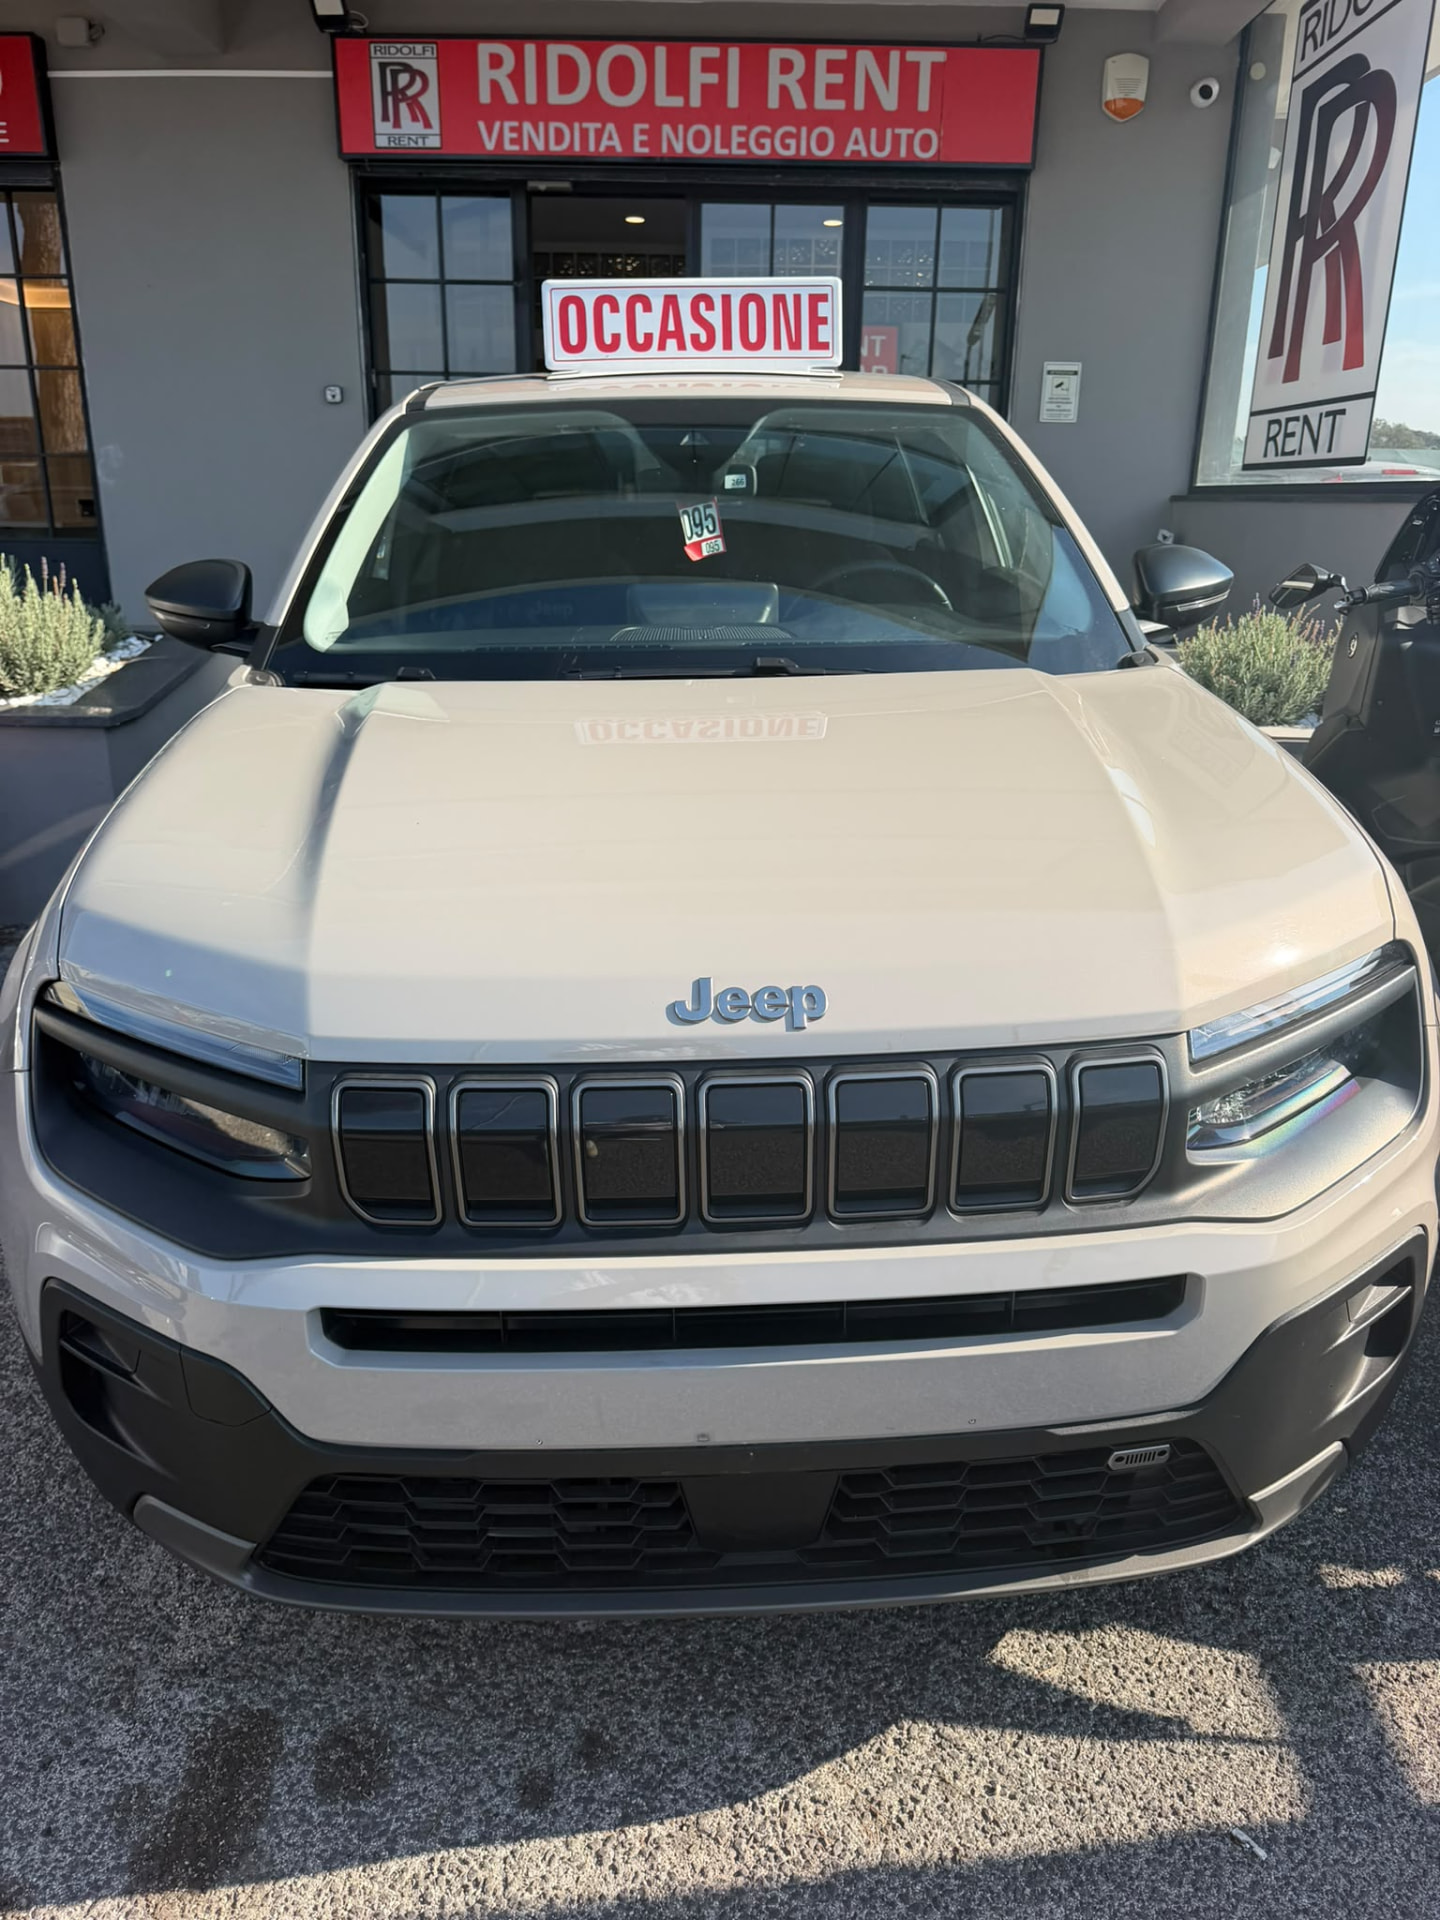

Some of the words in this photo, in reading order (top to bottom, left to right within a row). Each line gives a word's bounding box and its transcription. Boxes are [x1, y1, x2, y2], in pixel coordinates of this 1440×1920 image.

[373, 45, 435, 56] RIDOLFI
[477, 43, 740, 108] RIDOLFI
[767, 48, 947, 112] RENT
[387, 136, 429, 146] RENT
[477, 121, 622, 153] VENDITA
[633, 123, 650, 153] E
[661, 124, 835, 157] NOLEGGIO
[844, 127, 938, 159] AUTO
[558, 293, 830, 354] OCCASIONE
[1263, 408, 1347, 458] RENT
[667, 977, 828, 1031] Jeep
